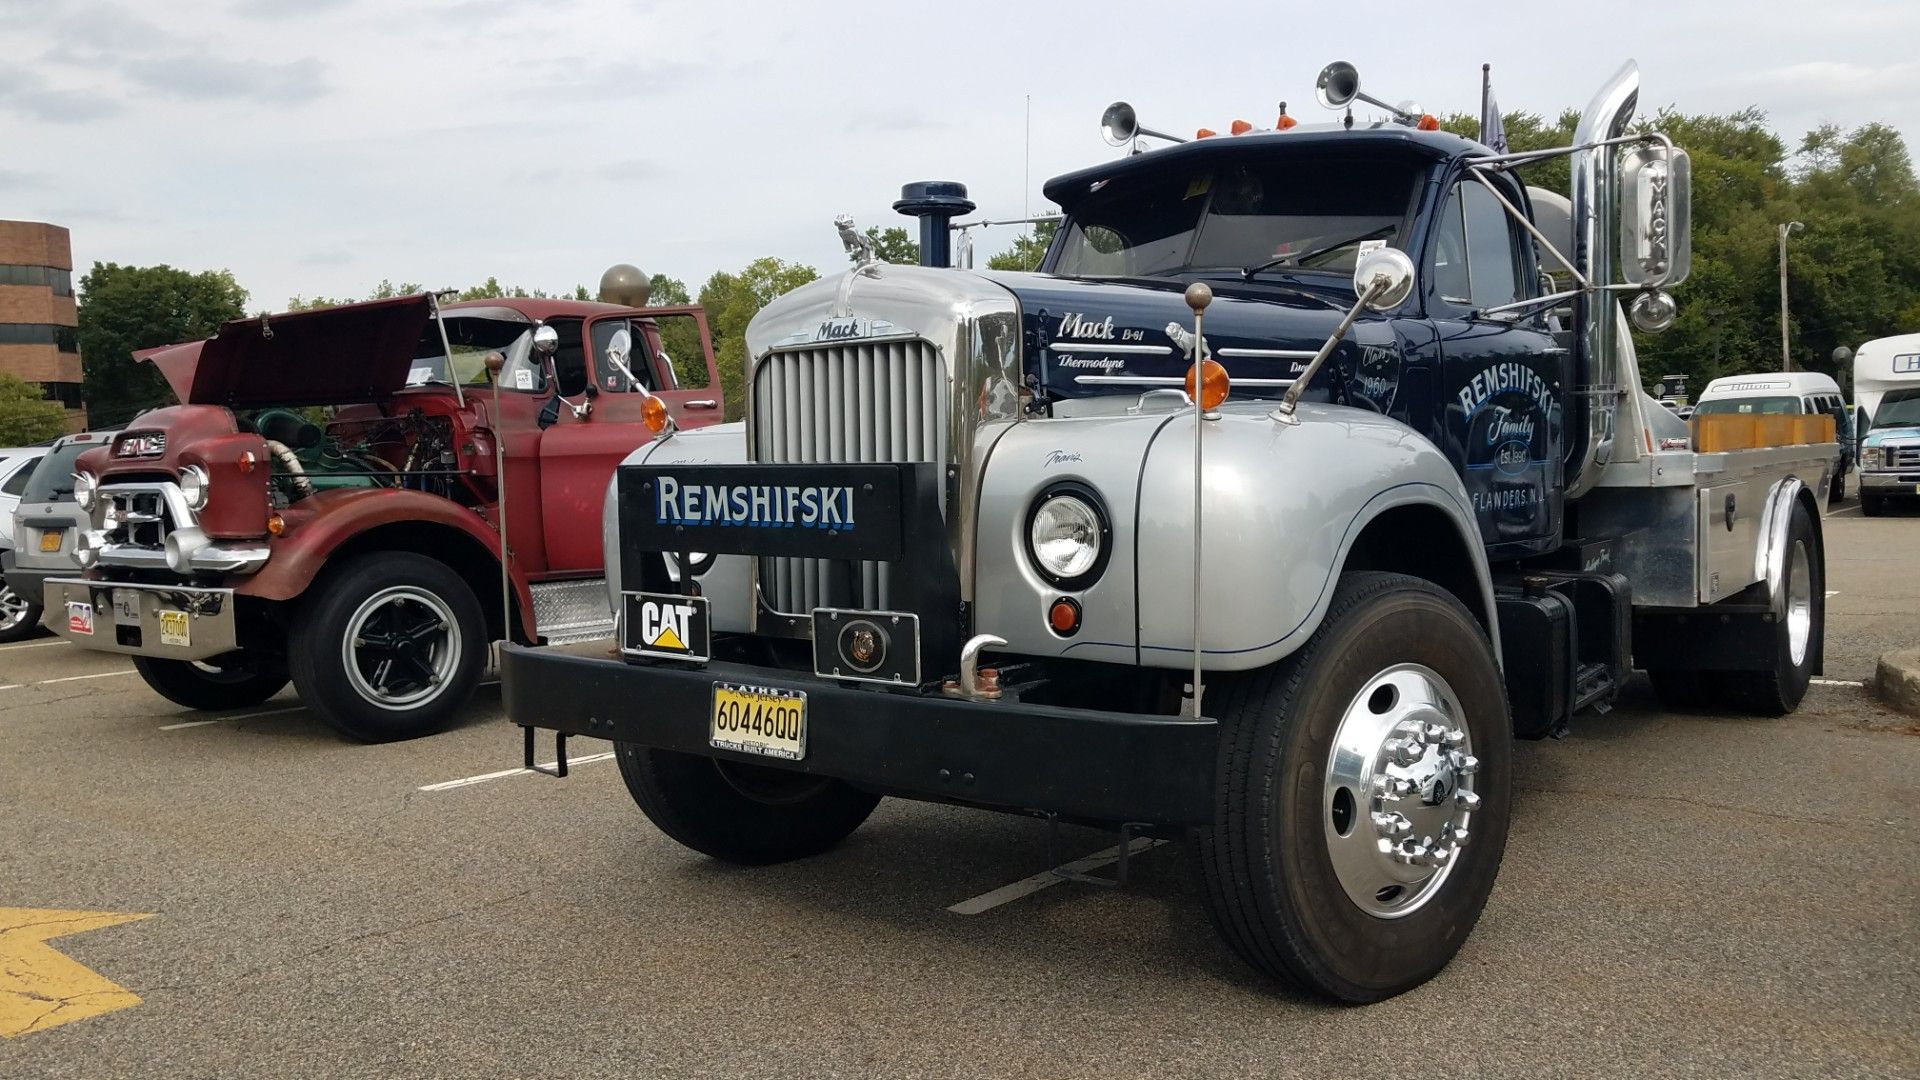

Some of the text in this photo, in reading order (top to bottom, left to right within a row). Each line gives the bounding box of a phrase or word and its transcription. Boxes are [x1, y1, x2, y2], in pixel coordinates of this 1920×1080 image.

[815, 318, 860, 340] Mack
[1056, 311, 1115, 340] Mack
[1057, 354, 1125, 373] Thermodyne
[1363, 376, 1387, 395] 1960
[1488, 406, 1535, 442] Family
[657, 475, 855, 529] REMSHIFSKI
[641, 601, 692, 650] CAT
[739, 685, 779, 695] ATHS
[717, 700, 799, 741] 60446QQ
[716, 741, 795, 760] TRUCKS BUILT AMERICA
